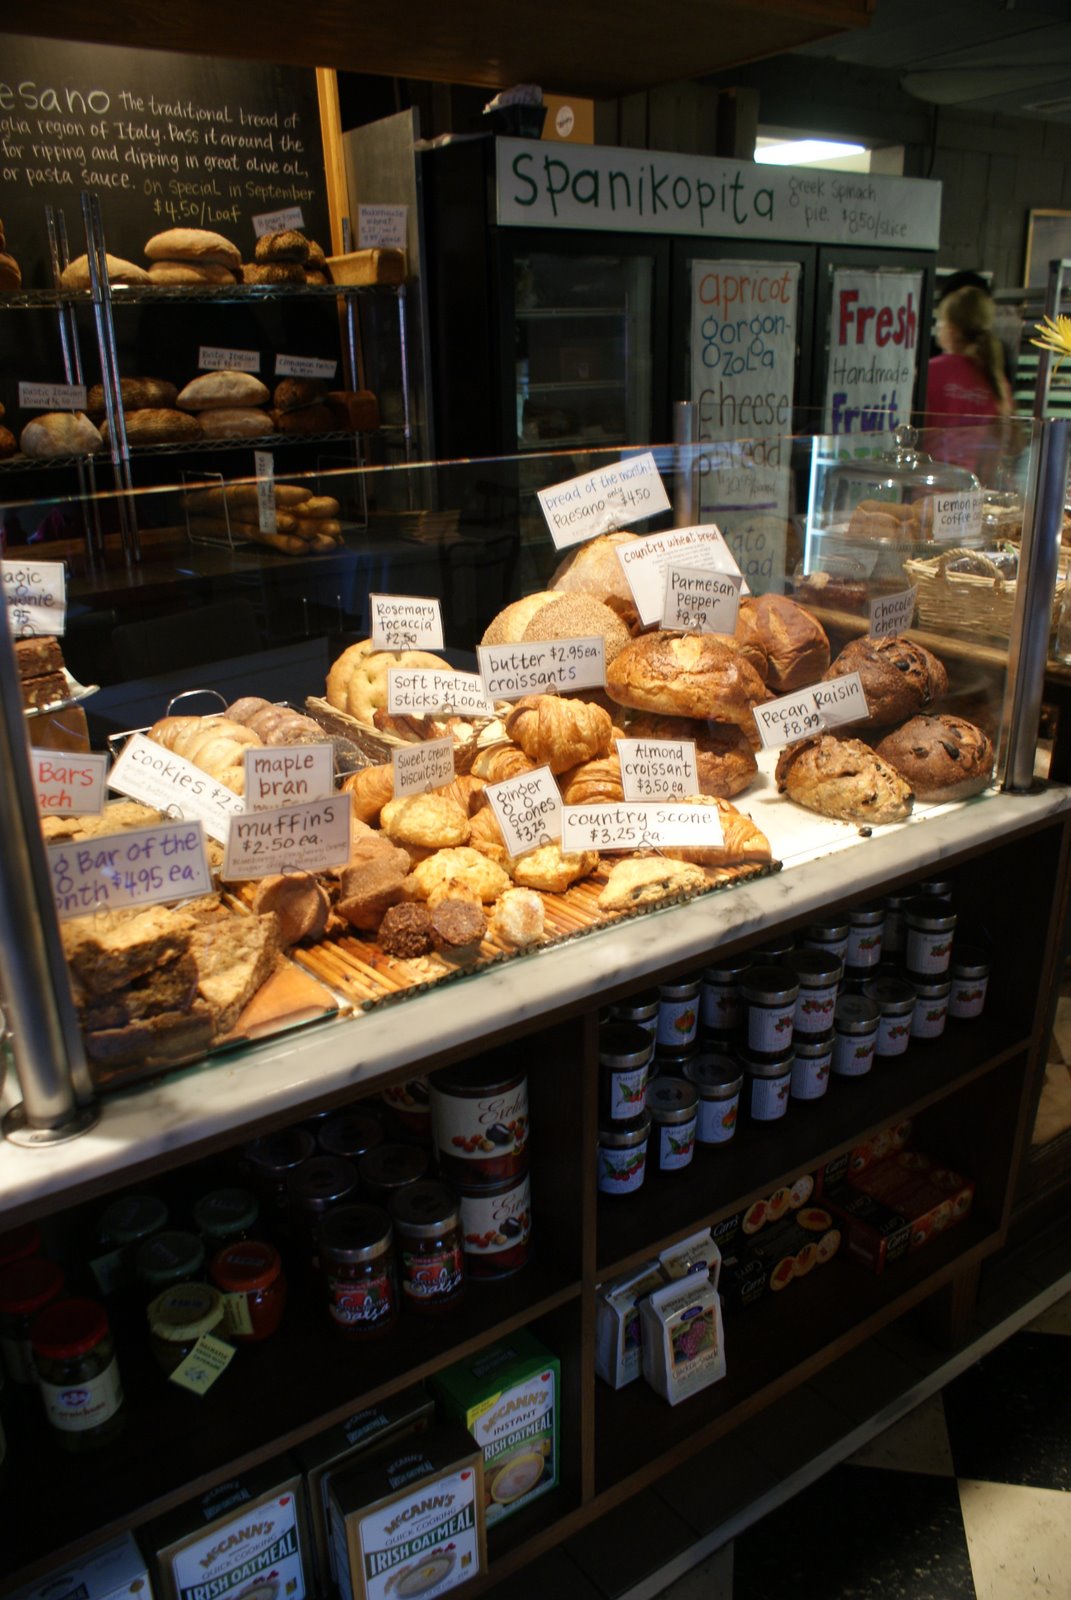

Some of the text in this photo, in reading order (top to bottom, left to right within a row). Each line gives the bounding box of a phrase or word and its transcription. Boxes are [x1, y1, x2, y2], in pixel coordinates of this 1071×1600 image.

[148, 95, 232, 123] traditional
[284, 112, 298, 128] of
[37, 119, 85, 140] region
[91, 120, 108, 139] of
[168, 122, 199, 145] Pass
[220, 132, 273, 152] around
[280, 134, 304, 153] the
[32, 141, 86, 166] ripping
[91, 145, 119, 162] and
[125, 146, 179, 173] dipping
[185, 152, 199, 168] in
[204, 153, 240, 171] great
[246, 156, 280, 174] olive
[3, 167, 19, 181] or
[26, 167, 74, 187] pasta
[511, 152, 774, 227] Spanikopita
[229, 184, 242, 198] in
[245, 181, 315, 202] September
[700, 271, 792, 321] apricot
[838, 288, 917, 350] Fresh
[833, 354, 910, 385] Handmade
[831, 389, 901, 435] Fruit
[545, 488, 581, 511] bread
[585, 479, 596, 494] of
[601, 472, 618, 489] the
[552, 499, 606, 529] Paesano
[621, 488, 651, 508] $4.50
[937, 499, 971, 513] Lemon
[667, 531, 697, 548] wheat
[671, 571, 735, 597] Parmesan
[376, 603, 434, 621] Rosemary
[378, 617, 433, 632] focaccia
[676, 609, 707, 626] $8.99
[488, 652, 546, 675] butter
[433, 674, 481, 693] Pretzel
[487, 666, 577, 693] croissants
[394, 692, 439, 706] sticks
[760, 680, 860, 728] Pecan Raisin
[783, 713, 820, 738] $8.99
[634, 743, 684, 761] Almond
[39, 762, 95, 787] Bars
[131, 749, 207, 796] cookies
[254, 754, 314, 779] maple
[624, 761, 692, 778] croissant
[259, 777, 308, 799] bran
[496, 778, 543, 816] ginger
[637, 777, 669, 795] $3.50
[237, 805, 335, 838] muffins
[515, 818, 546, 844] $3.25
[567, 808, 713, 832] country scone
[242, 837, 296, 855] $2.50
[589, 827, 636, 844] $3.25
[77, 848, 119, 875] Bar
[127, 837, 156, 861] of
[160, 831, 199, 857] the
[112, 865, 163, 898] $4.95
[493, 1408, 537, 1436] INSTANT
[508, 1412, 552, 1446] OATMEAL
[370, 1507, 473, 1576] IRISH OATMEAL
[231, 1533, 297, 1583] OATMEAL
